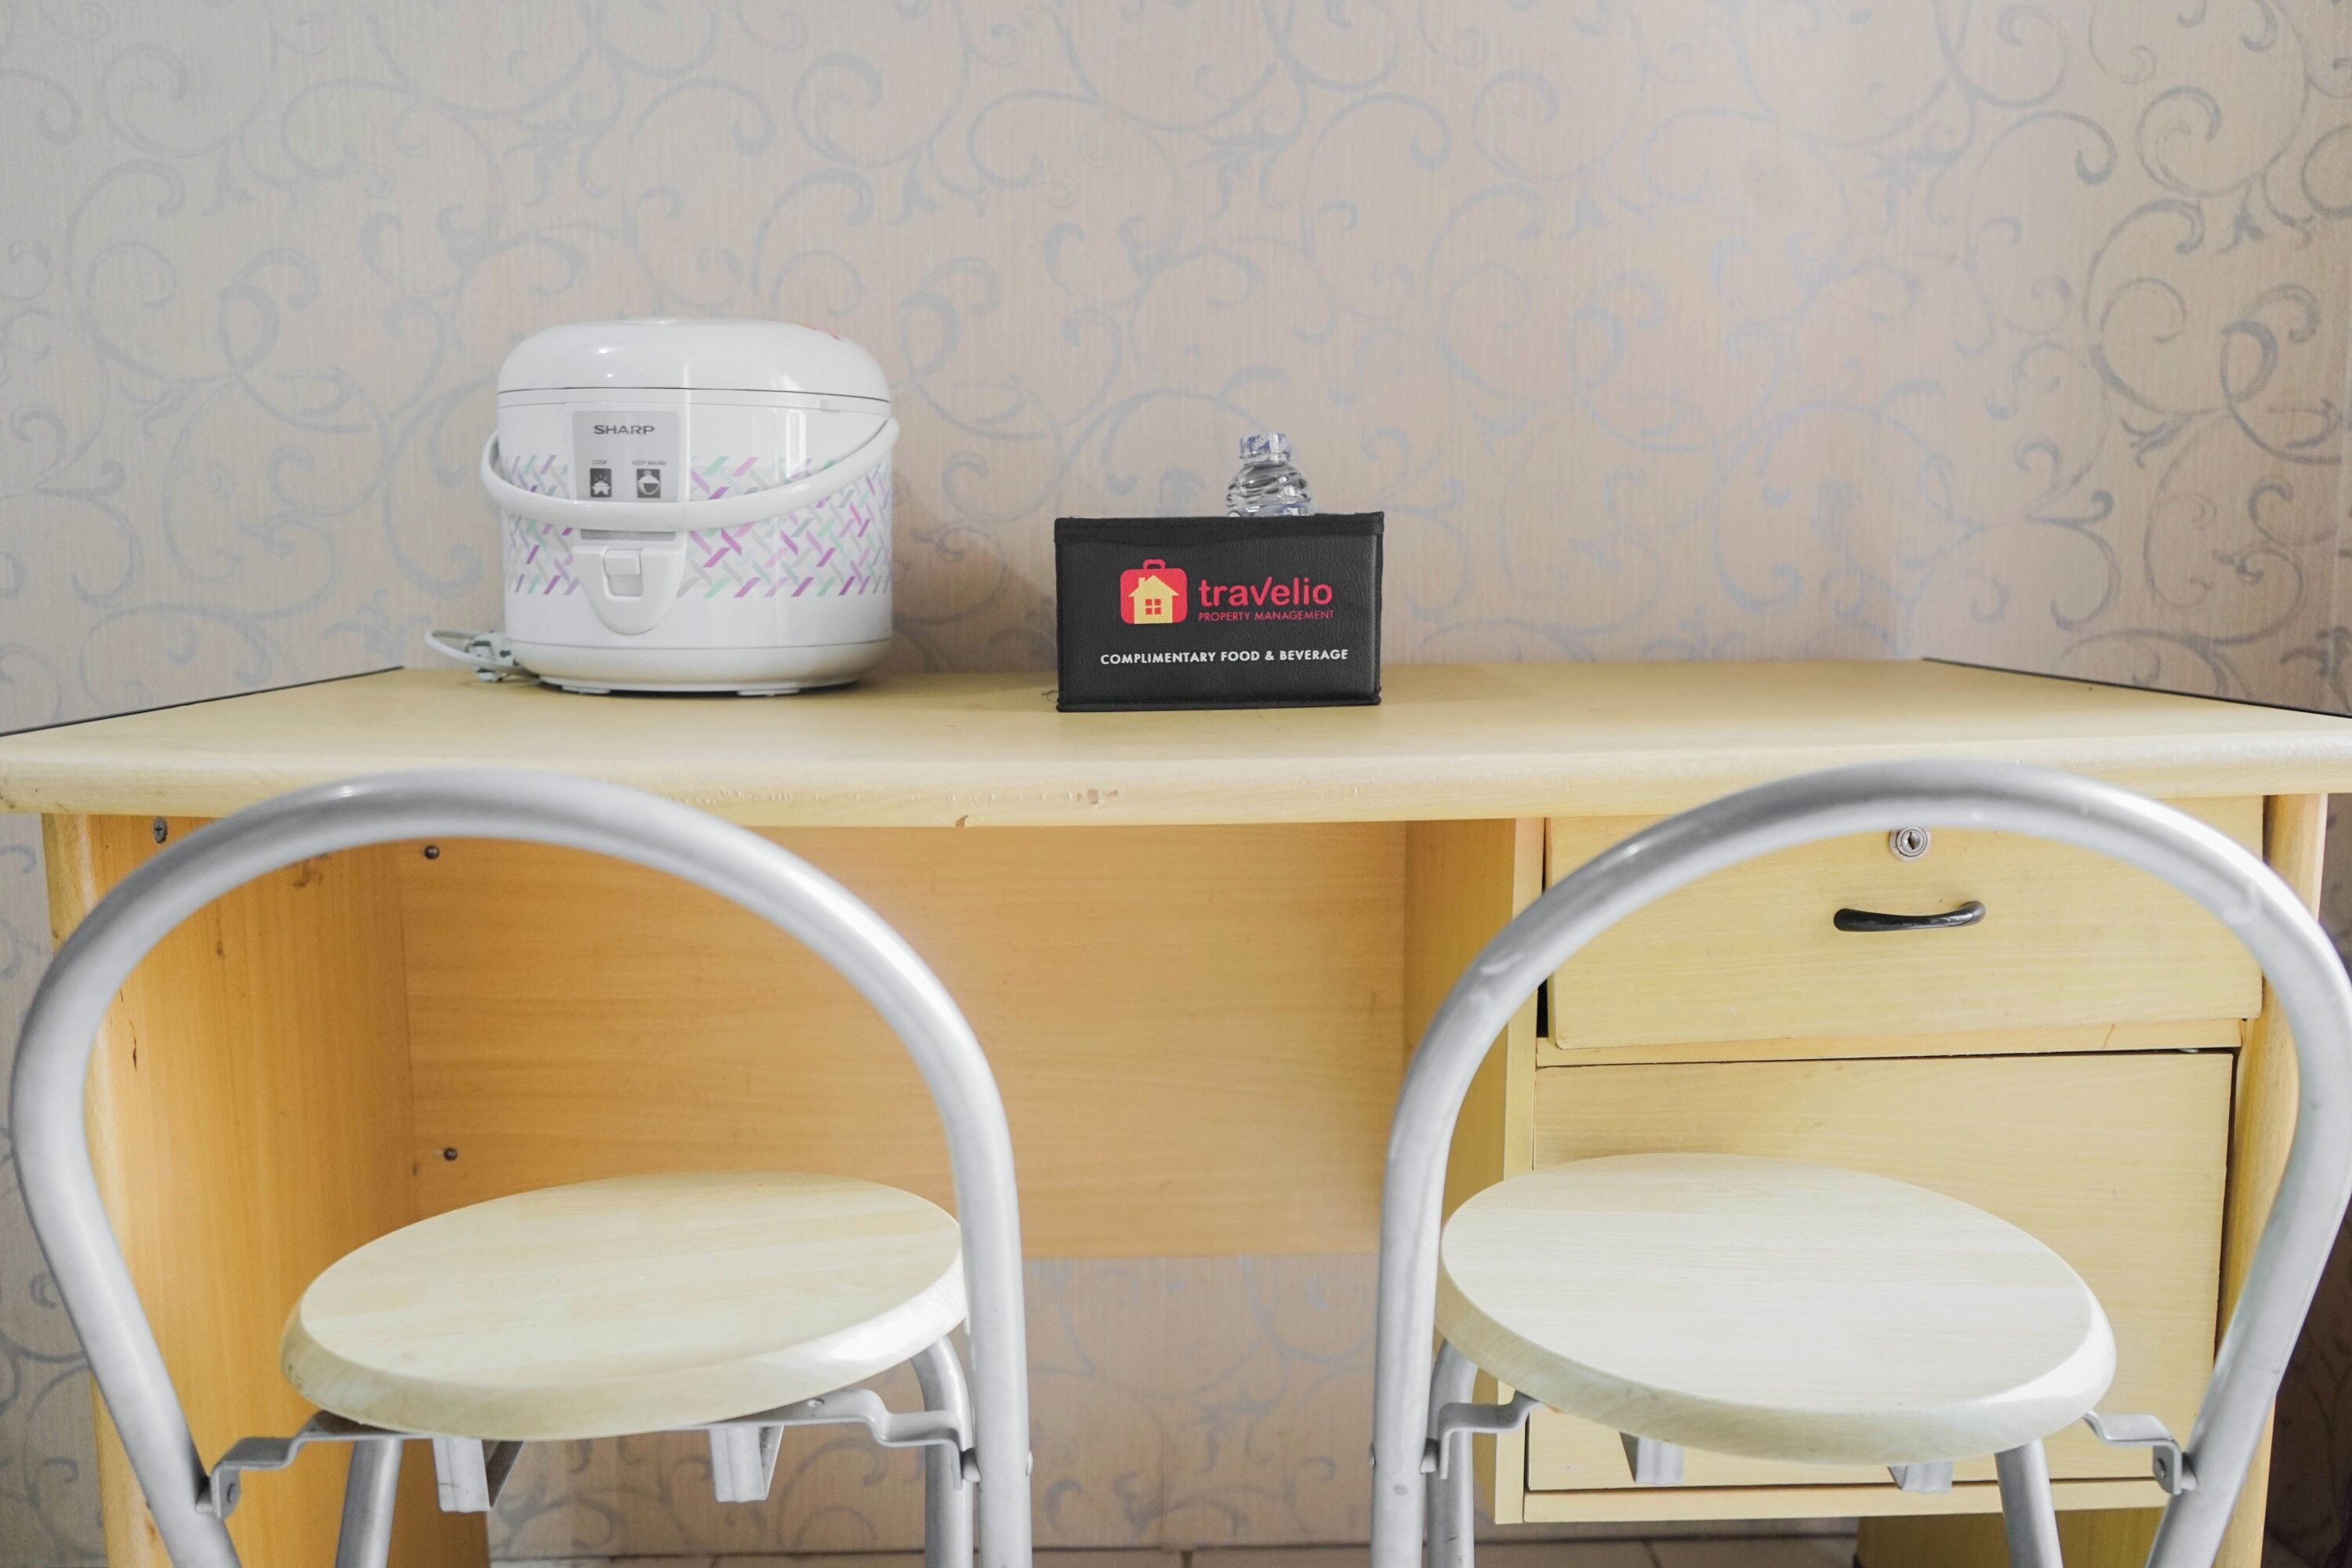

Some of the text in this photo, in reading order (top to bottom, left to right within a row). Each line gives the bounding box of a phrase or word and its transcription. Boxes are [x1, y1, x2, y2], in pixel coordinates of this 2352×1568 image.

[593, 425, 655, 434] SHARP
[1198, 576, 1333, 608] travelio
[1199, 610, 1334, 622] PROPERTY MANAGEMENT
[1101, 649, 1348, 665] COMPLIMENTARY FOOD & BEVERAGE
